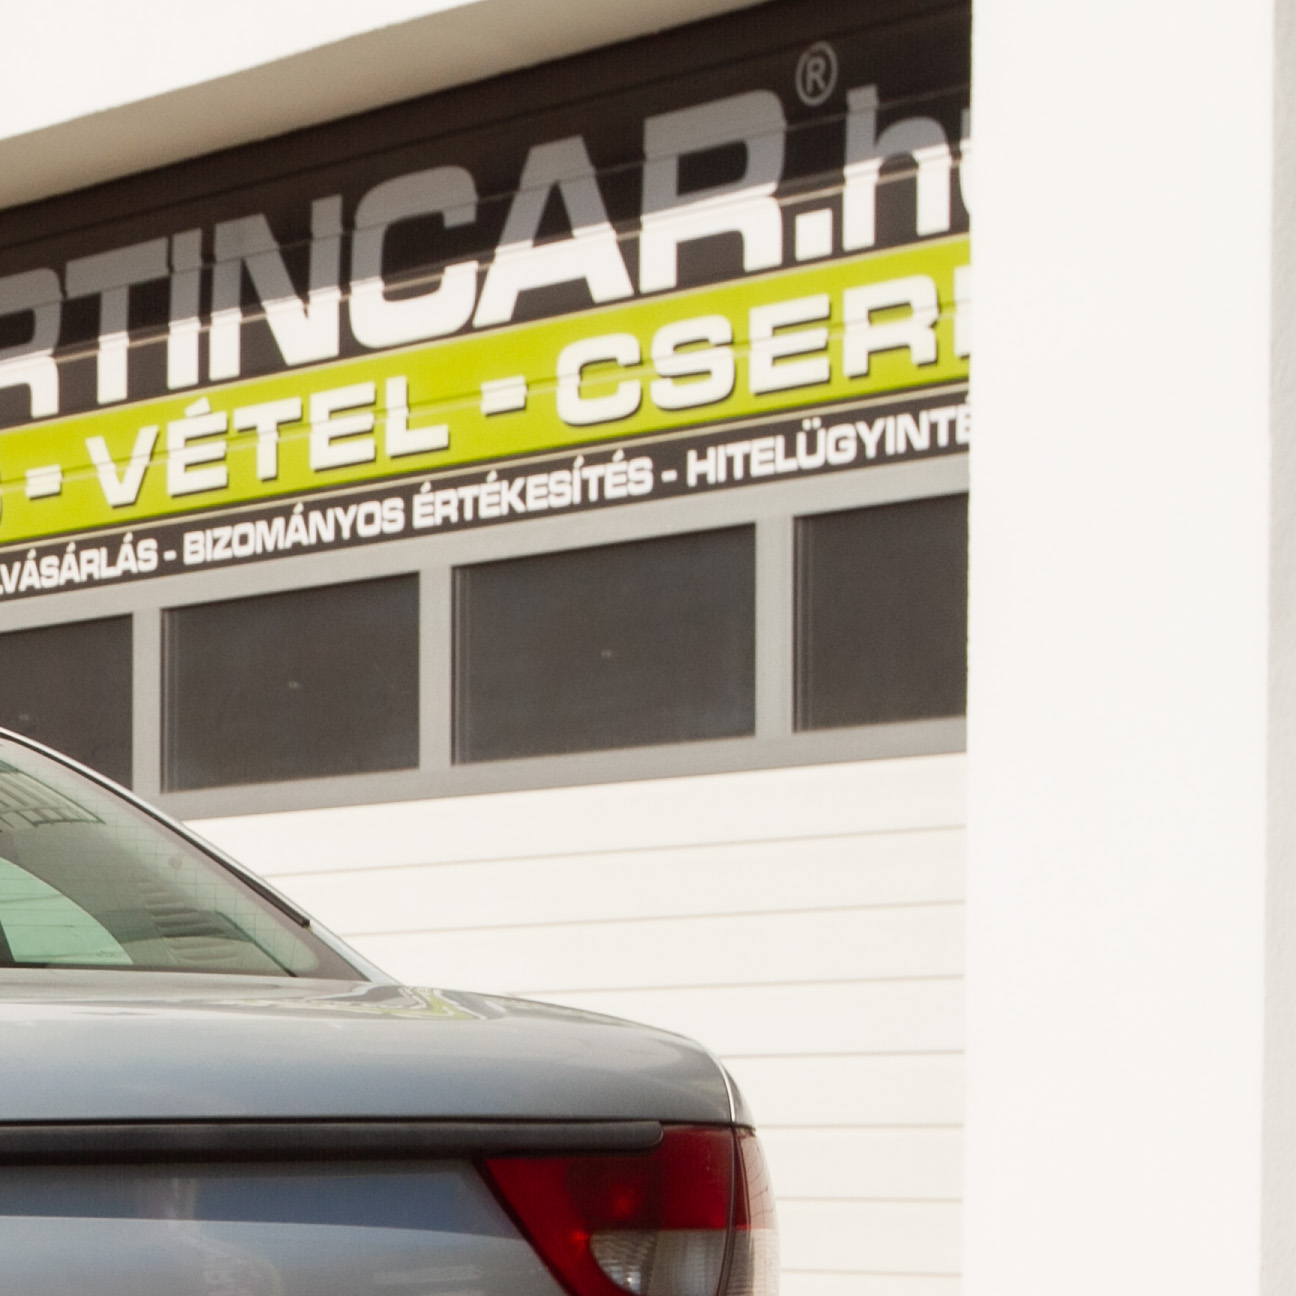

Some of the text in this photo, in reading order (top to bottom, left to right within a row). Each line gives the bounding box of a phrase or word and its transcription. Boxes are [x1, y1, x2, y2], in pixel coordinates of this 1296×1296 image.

[84, 375, 450, 508] VÉTEL
[555, 264, 970, 427] CSER
[183, 497, 405, 566] BIZOMÁNYOS
[412, 448, 654, 530] ÉRTÉKESÍTÉS
